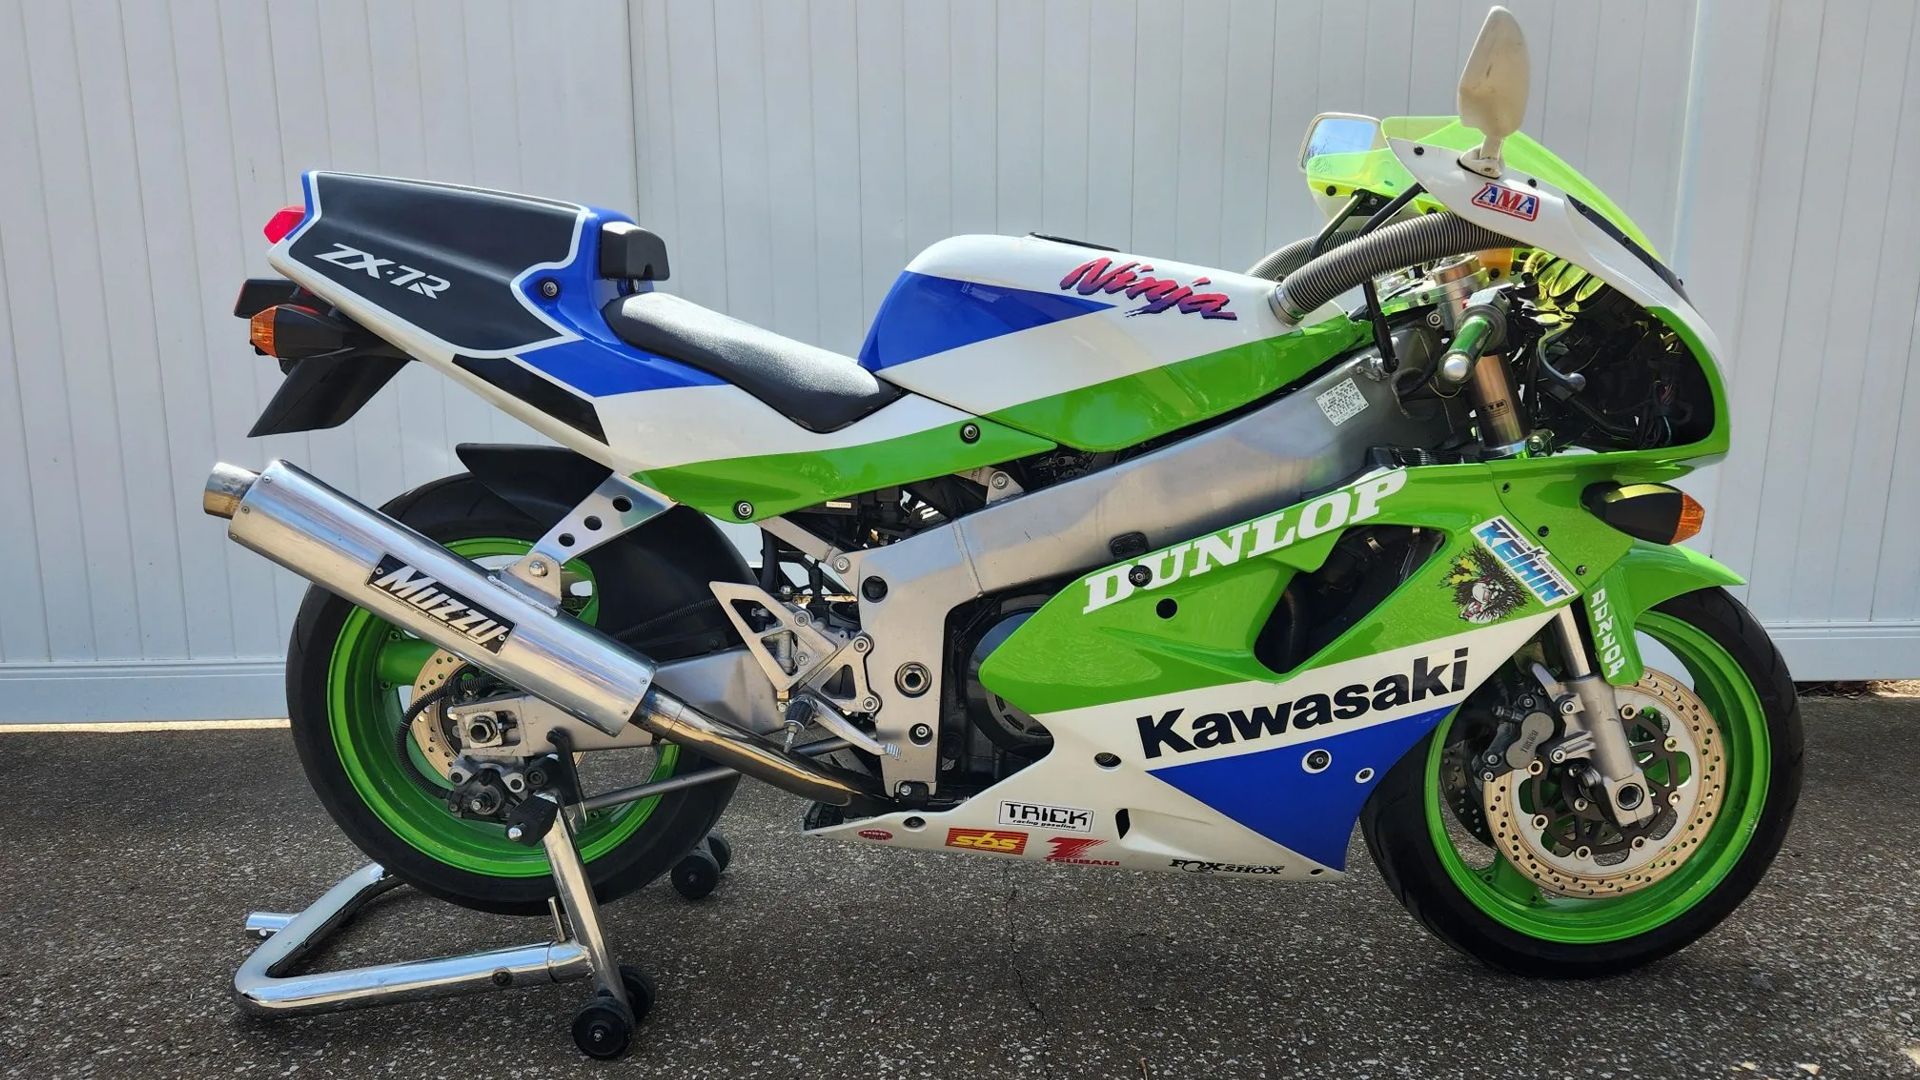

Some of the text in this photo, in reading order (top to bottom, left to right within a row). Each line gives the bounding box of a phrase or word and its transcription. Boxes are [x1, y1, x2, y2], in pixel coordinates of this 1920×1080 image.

[1479, 186, 1536, 214] AMA
[1059, 257, 1238, 320] Ninja
[1083, 469, 1407, 615] DUNLOP
[1477, 519, 1569, 602] KEIHIN
[1590, 588, 1625, 678] DUNLOP
[1136, 647, 1469, 759] Kawasaki
[952, 832, 1020, 850] sbs
[1005, 803, 1089, 826] TRICK
[1041, 821, 1077, 830] gasoline
